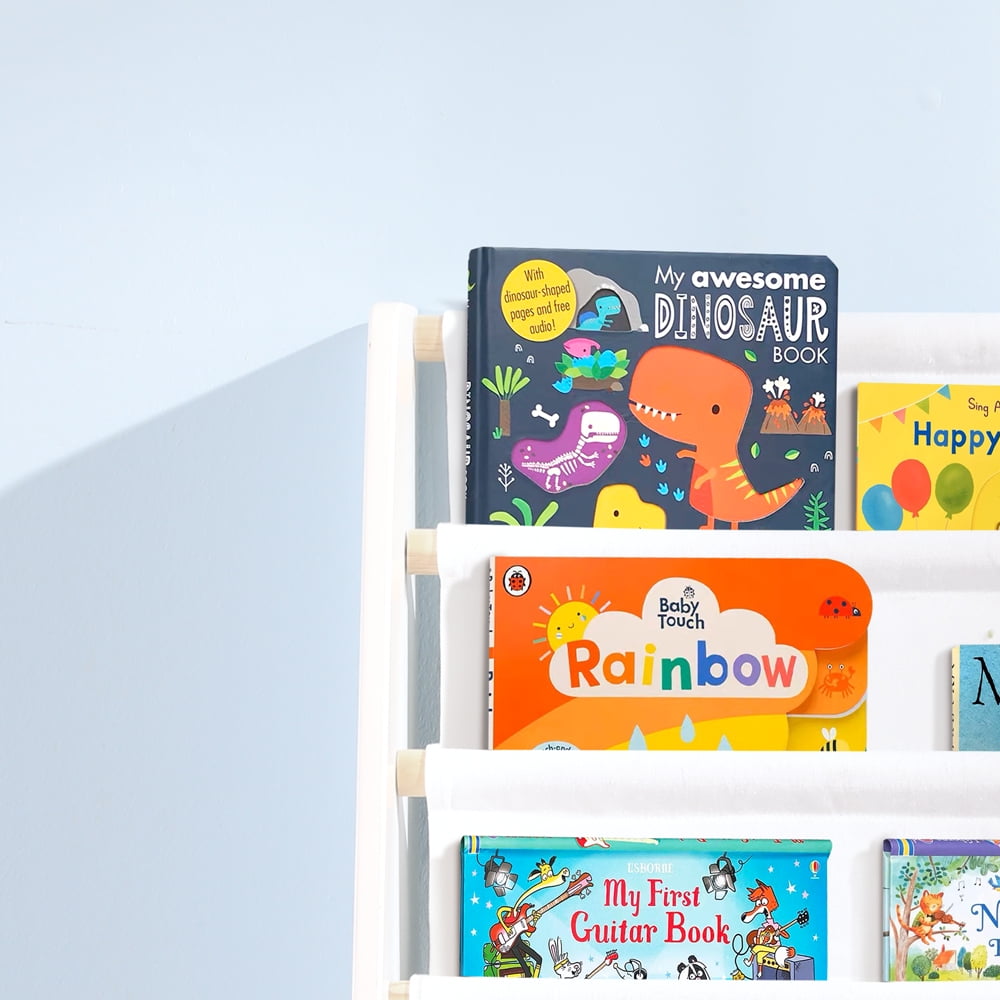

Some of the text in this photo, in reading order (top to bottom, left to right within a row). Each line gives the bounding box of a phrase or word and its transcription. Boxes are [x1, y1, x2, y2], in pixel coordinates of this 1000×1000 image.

[524, 267, 544, 281] With
[655, 265, 826, 291] My awesome
[504, 280, 571, 303] dinosaur-shaped
[510, 300, 570, 322] pages and free
[655, 293, 829, 342] DINOSAUR
[530, 319, 556, 335] audio!
[773, 347, 828, 364] BOOK
[968, 397, 988, 417] Sing
[659, 598, 699, 616] Baby
[658, 614, 704, 629] Touch
[567, 640, 796, 690] Rainbow
[603, 878, 701, 917] My First
[570, 910, 731, 944] Guitar Book
